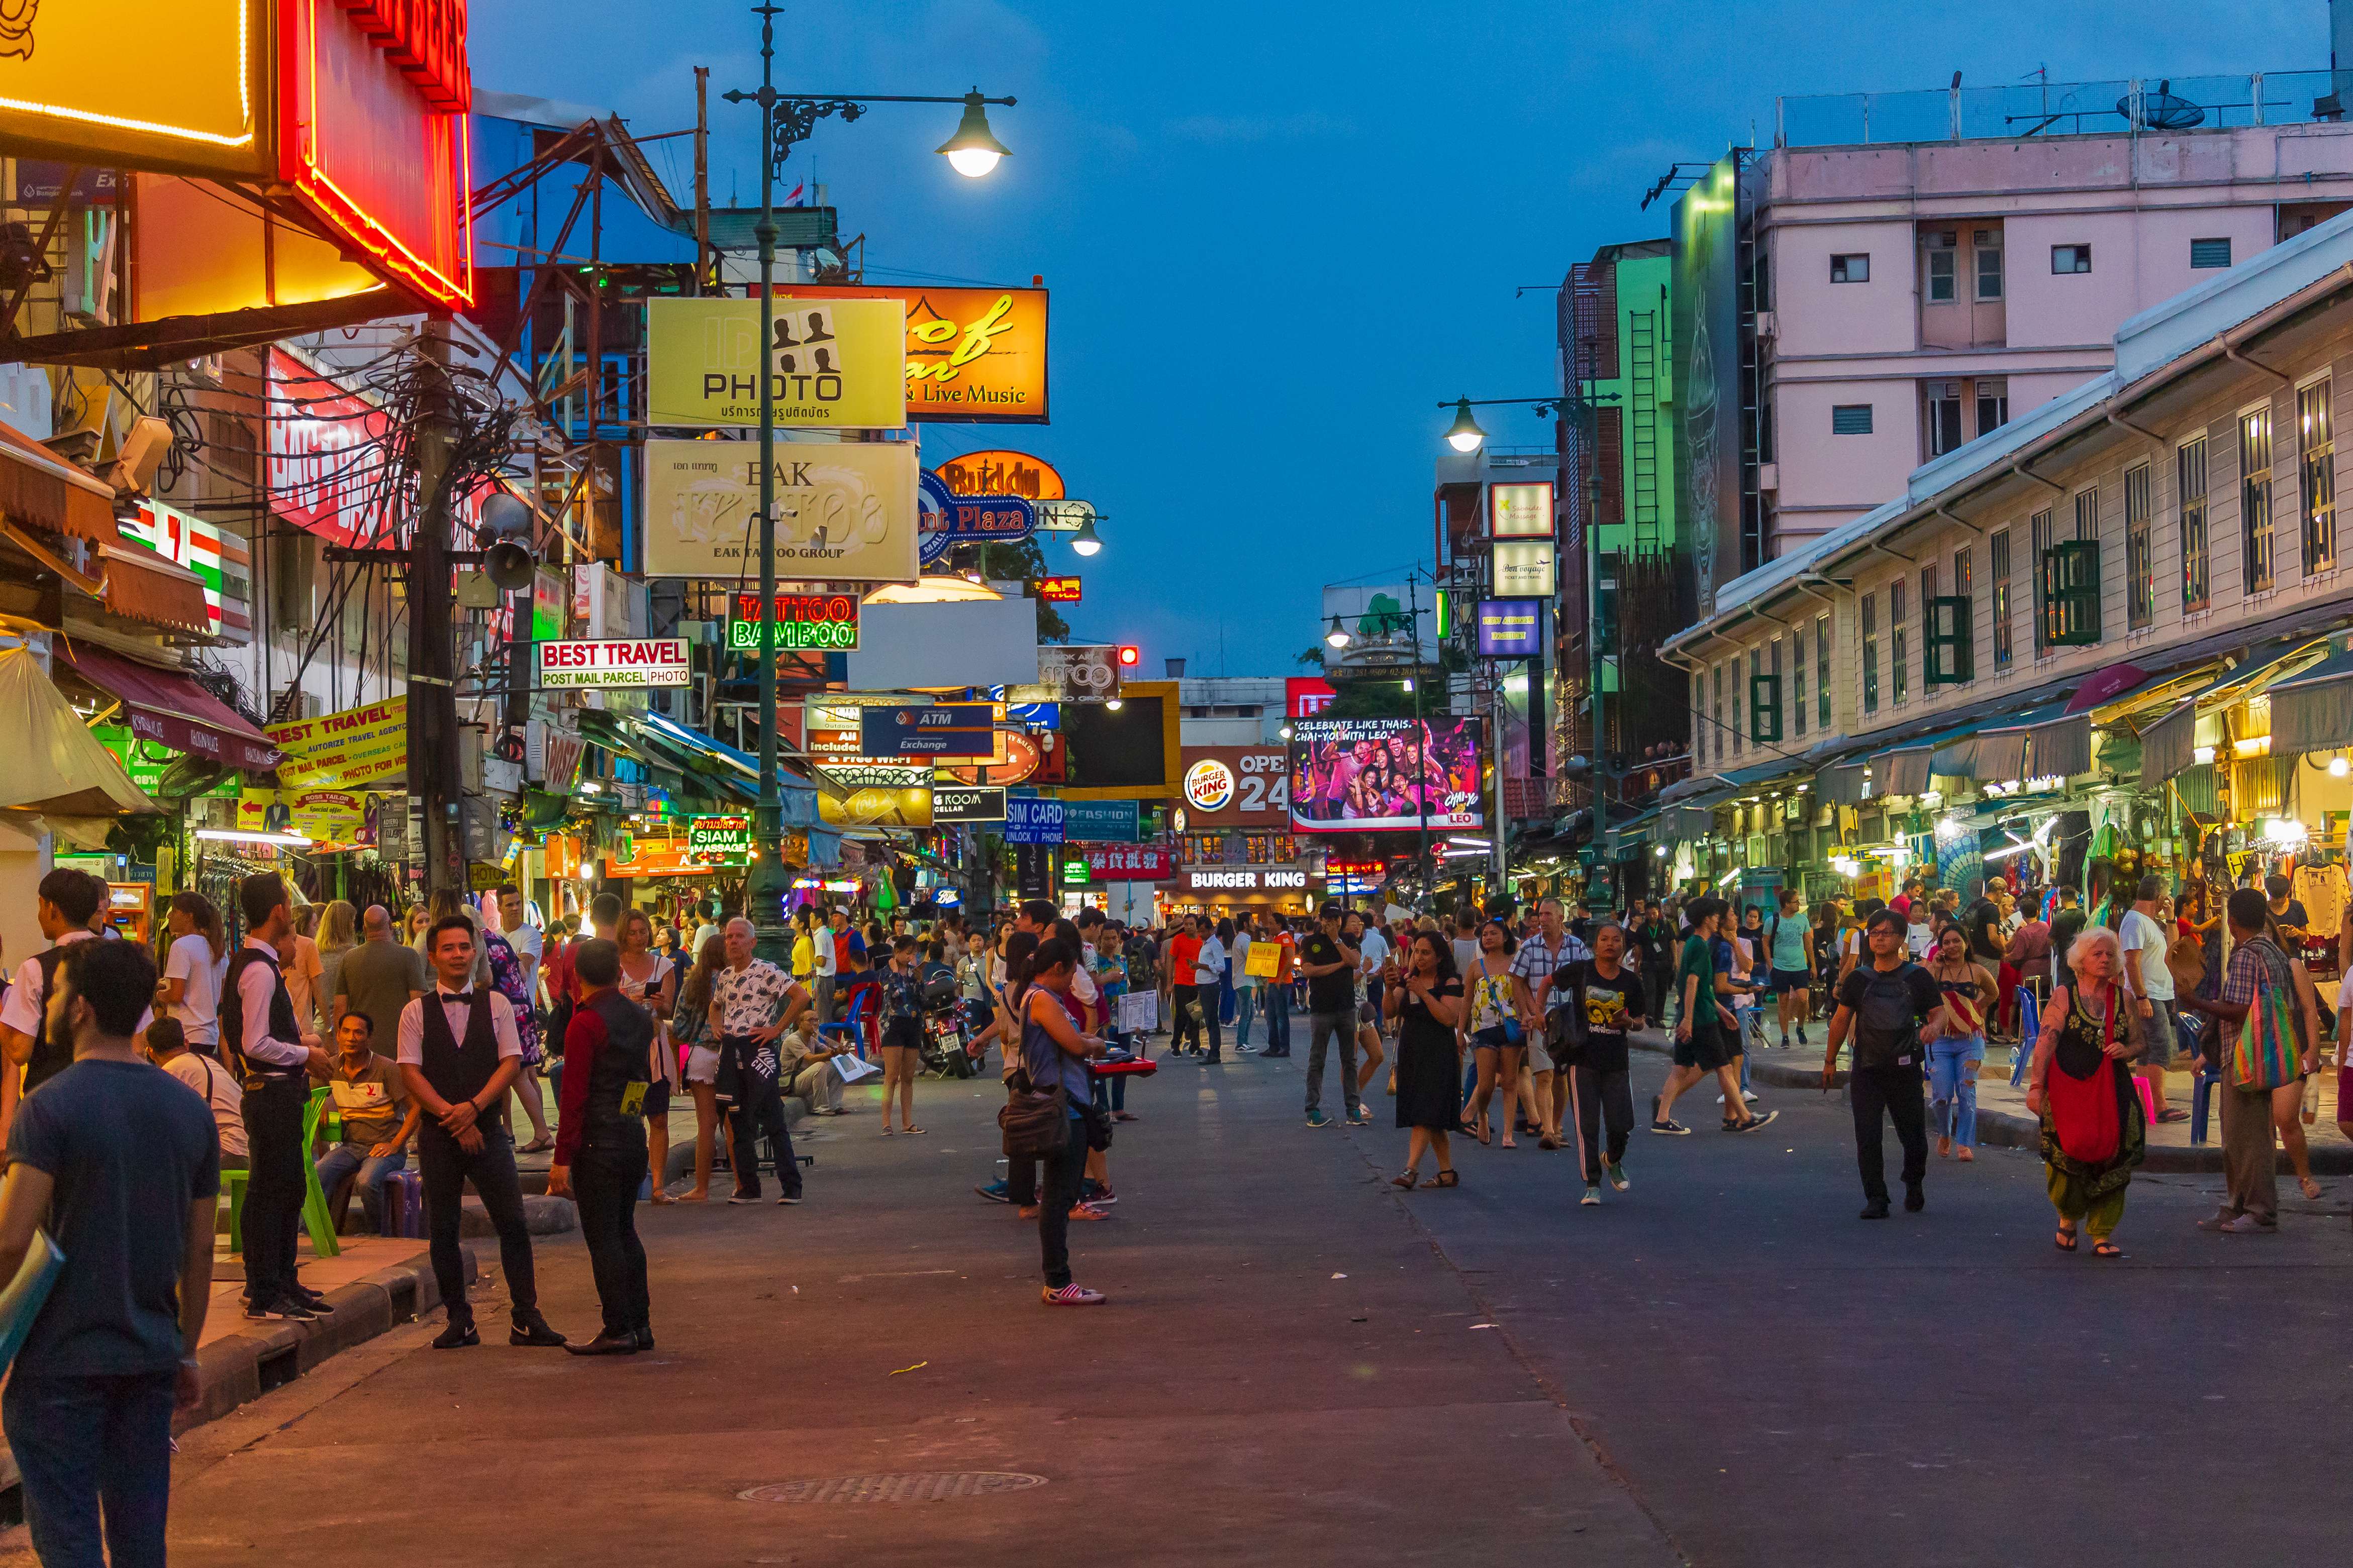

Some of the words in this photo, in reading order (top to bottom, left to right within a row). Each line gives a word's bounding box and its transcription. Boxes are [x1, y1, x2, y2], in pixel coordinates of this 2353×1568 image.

[924, 384, 963, 402] Live
[967, 385, 1026, 404] Music
[945, 461, 1040, 499] Buddy
[918, 507, 949, 532] int
[957, 506, 1025, 531] Plaza
[924, 531, 946, 554] MALL
[714, 548, 740, 558] EAK
[744, 548, 796, 558] TAOO
[799, 548, 845, 558] GROUP
[1519, 566, 1545, 575] voyage
[543, 644, 600, 667] BEST
[604, 642, 687, 665] TRAVEL
[543, 673, 572, 685] POST
[575, 672, 601, 684] MAIL
[604, 672, 646, 683] PARCEL
[651, 671, 688, 682] PHOTO
[268, 723, 313, 746] BEST
[321, 706, 391, 734] TRAVEL
[920, 714, 952, 724] ATM
[1356, 720, 1379, 729] LIKE
[1380, 719, 1412, 729] THAIS.
[307, 739, 345, 753] AUTORIZE
[347, 730, 375, 744] TRAVEL
[838, 731, 856, 741] All
[1342, 731, 1365, 741] WITH
[900, 741, 947, 751] Exchange
[1016, 739, 1034, 756] SALON
[316, 754, 347, 769] PARCEL
[352, 745, 391, 760] OVERSEAS
[1239, 755, 1288, 773] OPE
[342, 764, 372, 780] PHOTO
[374, 759, 393, 772] FOR
[1192, 770, 1225, 787] BURGER
[1194, 778, 1227, 800] KING
[1239, 776, 1288, 811] 24
[945, 794, 981, 804] ROOM
[1007, 803, 1027, 823] SIM
[1031, 804, 1063, 824] CARD
[1449, 814, 1472, 823] LEO
[356, 830, 366, 841] 69
[696, 830, 737, 843] SIAM
[1006, 831, 1031, 842] UNLOCK
[1041, 832, 1062, 843] PHONE
[694, 843, 747, 853] MASSAGE
[471, 867, 501, 880] HOTO
[1191, 872, 1257, 888] BURGER
[1264, 872, 1305, 887] KING
